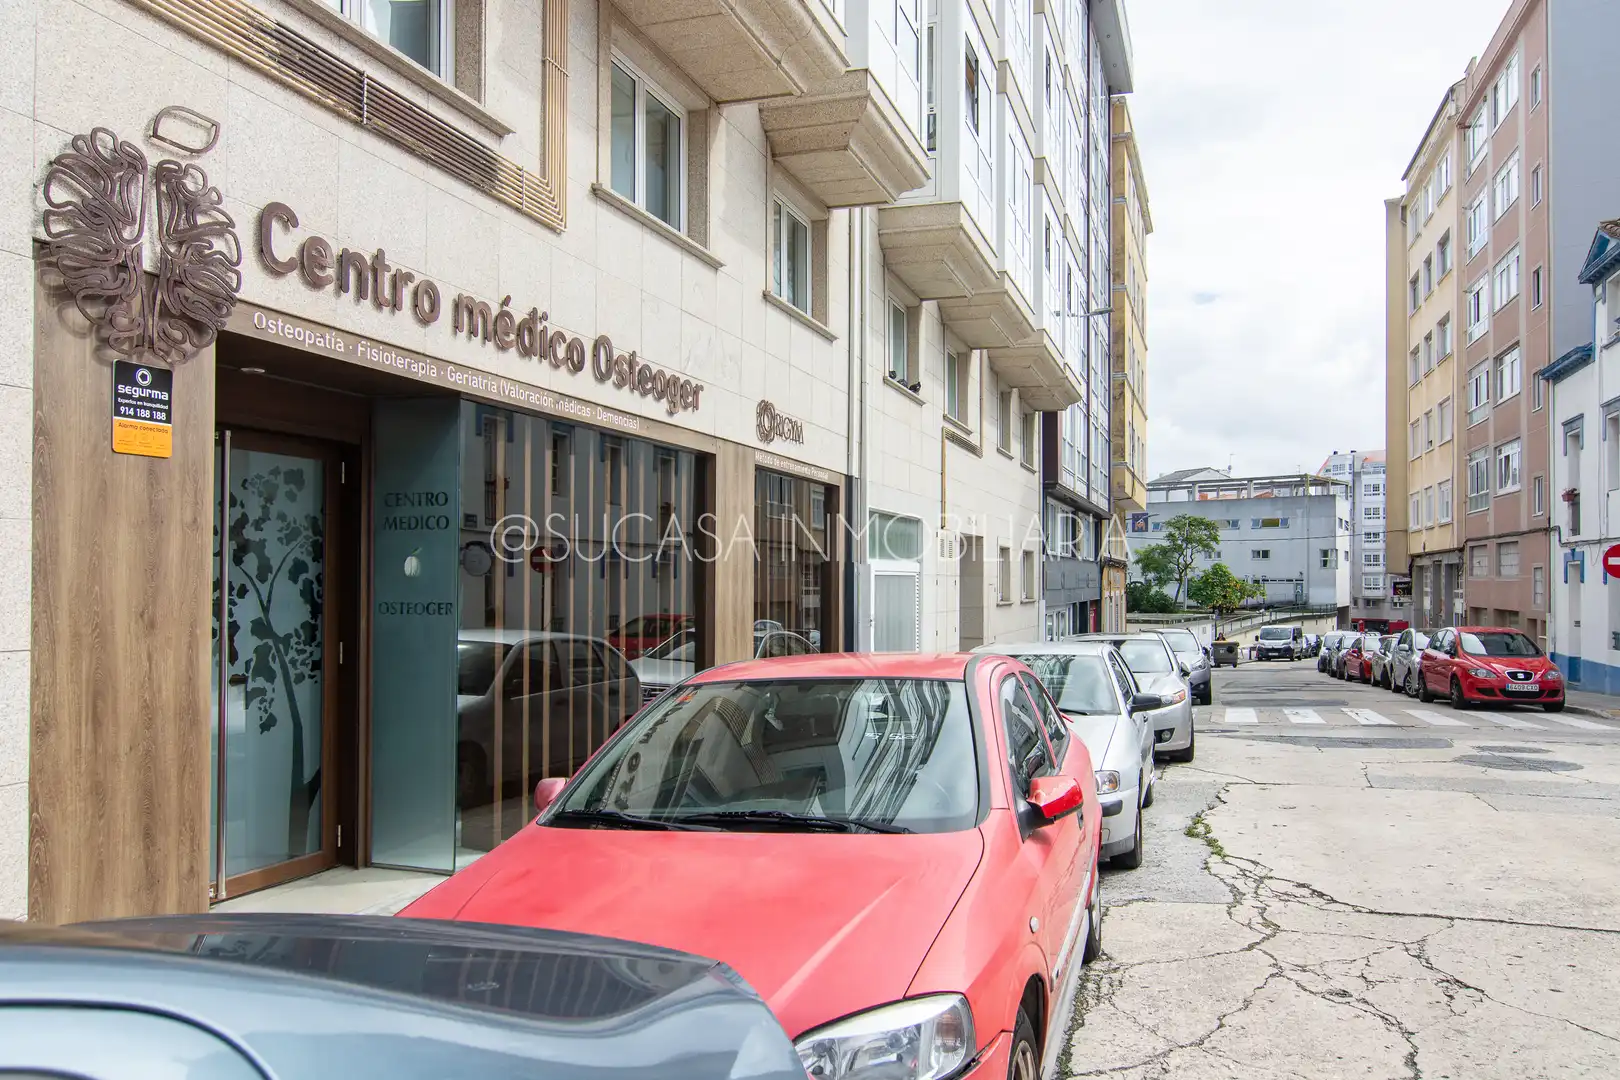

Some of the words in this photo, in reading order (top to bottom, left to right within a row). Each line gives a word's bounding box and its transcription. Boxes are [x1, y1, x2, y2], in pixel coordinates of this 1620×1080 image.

[261, 201, 441, 323] Centro
[456, 292, 586, 373] médico
[593, 334, 704, 415] Osteoger
[253, 311, 345, 353] Osteopatía
[357, 340, 437, 377] Fisioterapia
[597, 406, 640, 431] Demencias)
[117, 385, 168, 400] segurma
[120, 406, 134, 416] 914
[136, 408, 150, 418] 188
[152, 411, 166, 421] 188
[118, 422, 138, 430] Alarma
[384, 492, 449, 507] CENTRO
[383, 515, 450, 531] MEDICO
[378, 601, 453, 616] OSTEOGER
